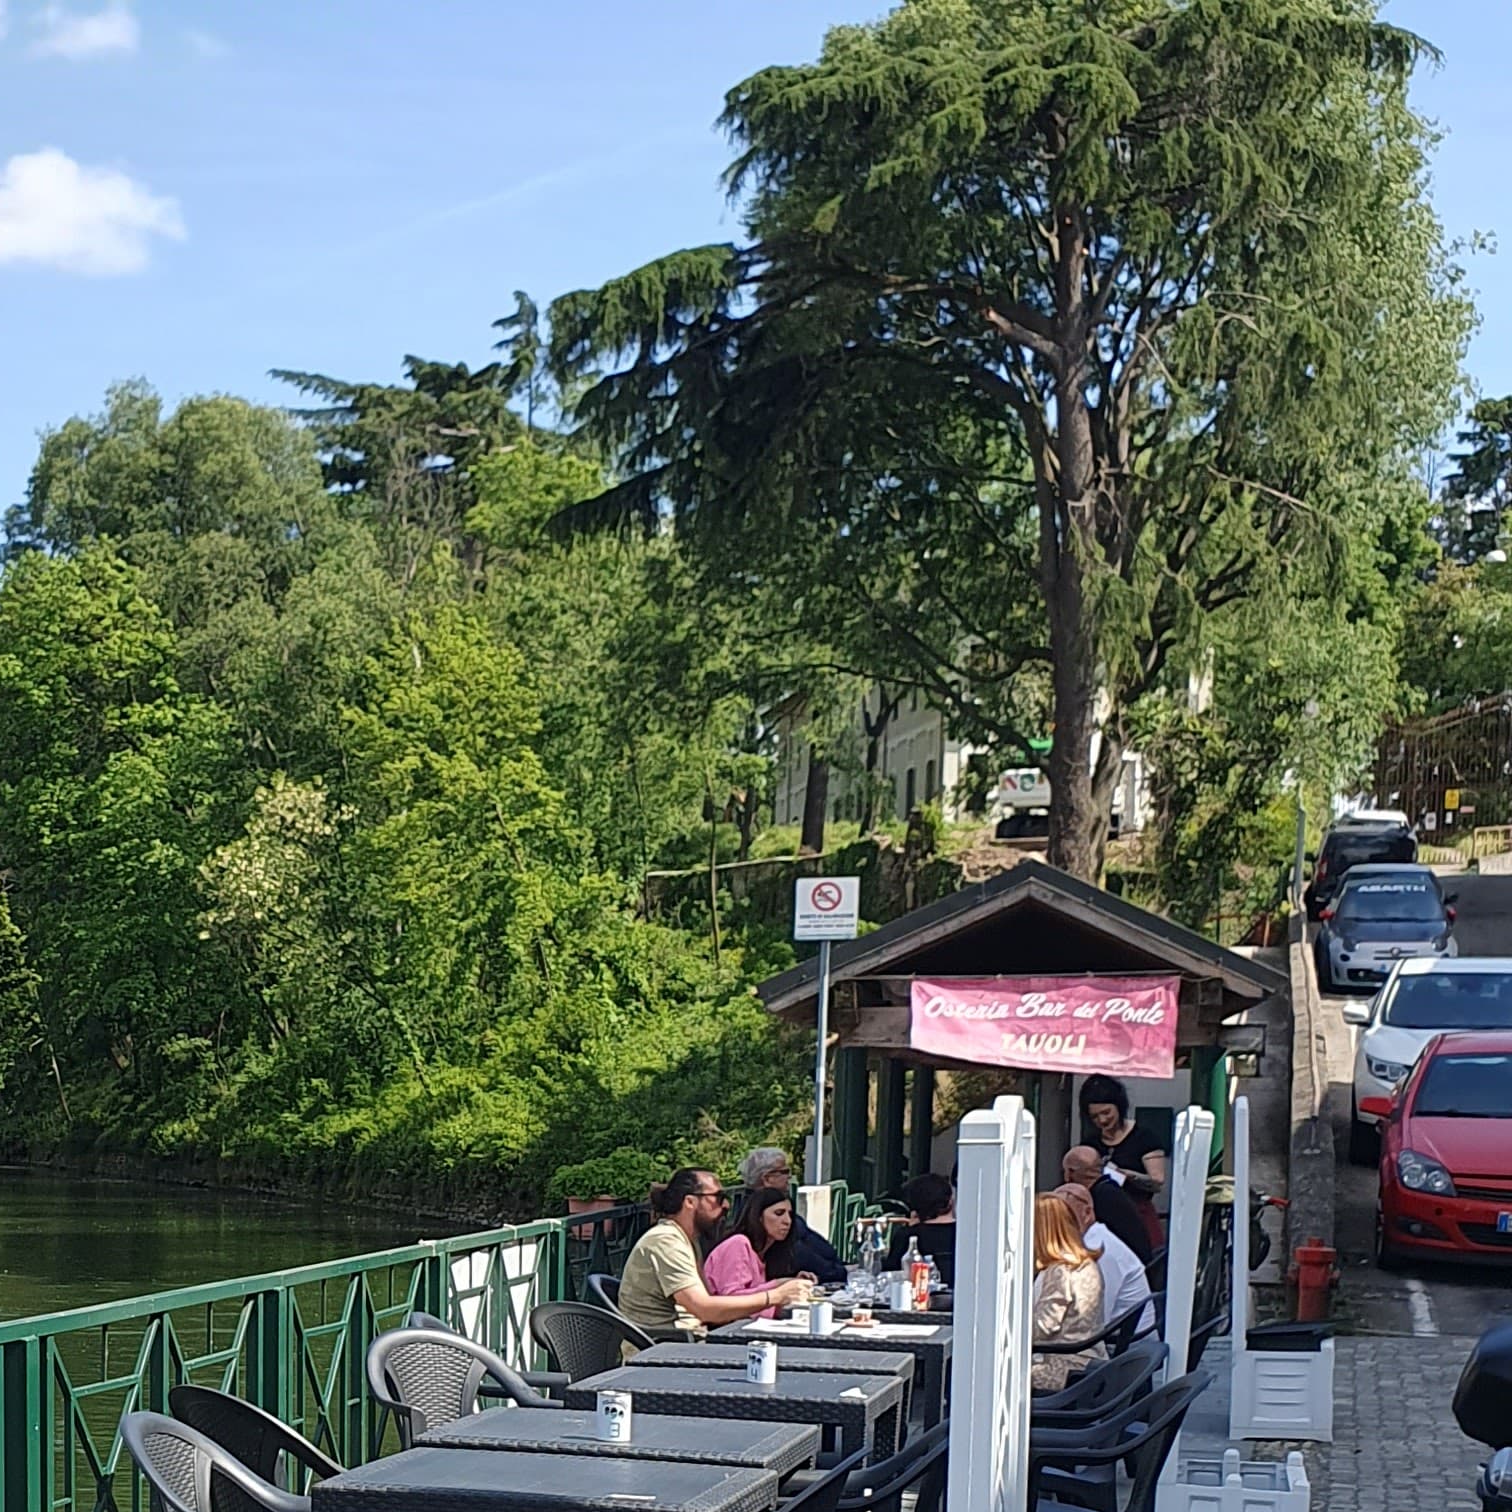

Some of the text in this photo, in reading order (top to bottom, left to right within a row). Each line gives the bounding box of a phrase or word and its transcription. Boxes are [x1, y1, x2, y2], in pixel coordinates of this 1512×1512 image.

[1357, 884, 1426, 893] ABARTH
[924, 992, 1166, 1025] Osteria Bar del Ponte
[1000, 1032, 1087, 1056] TAVOLI
[609, 1422, 621, 1438] 3
